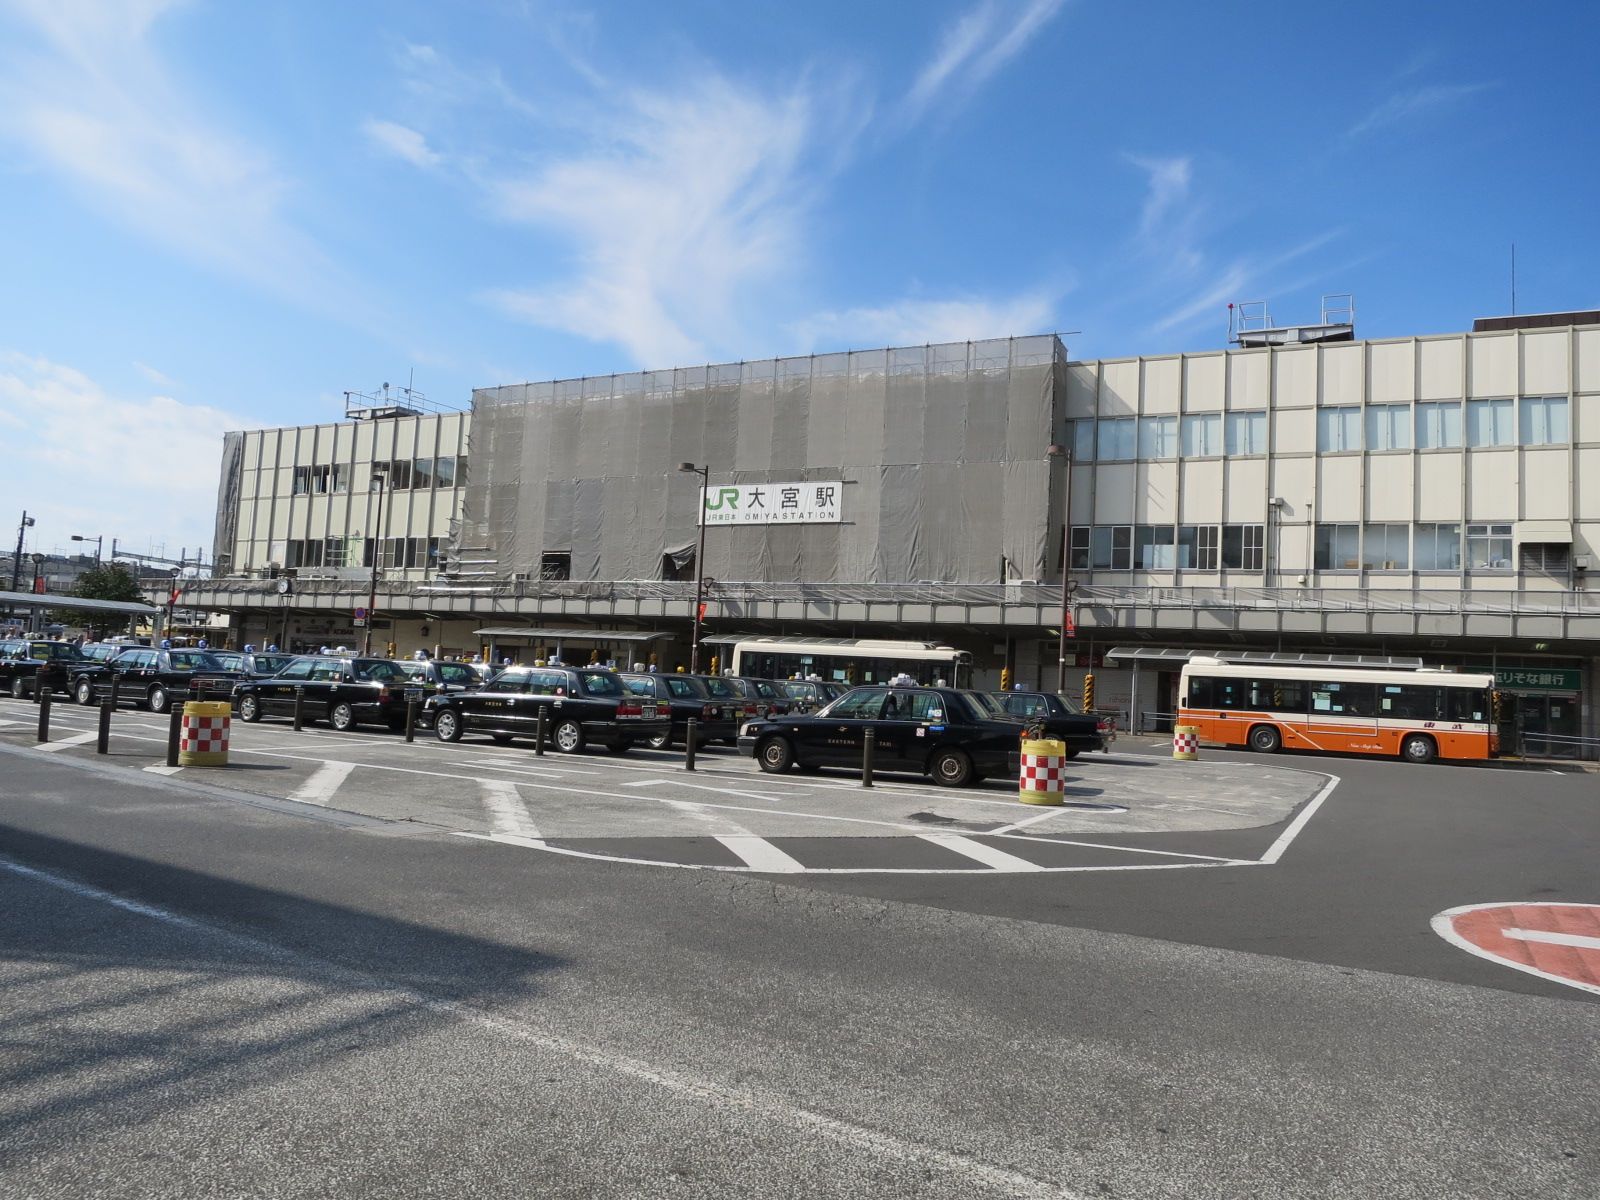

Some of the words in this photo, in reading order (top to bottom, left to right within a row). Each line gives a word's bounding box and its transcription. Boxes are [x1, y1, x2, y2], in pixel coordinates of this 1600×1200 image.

[706, 488, 739, 510] JR
[748, 486, 835, 509] 大宮駅
